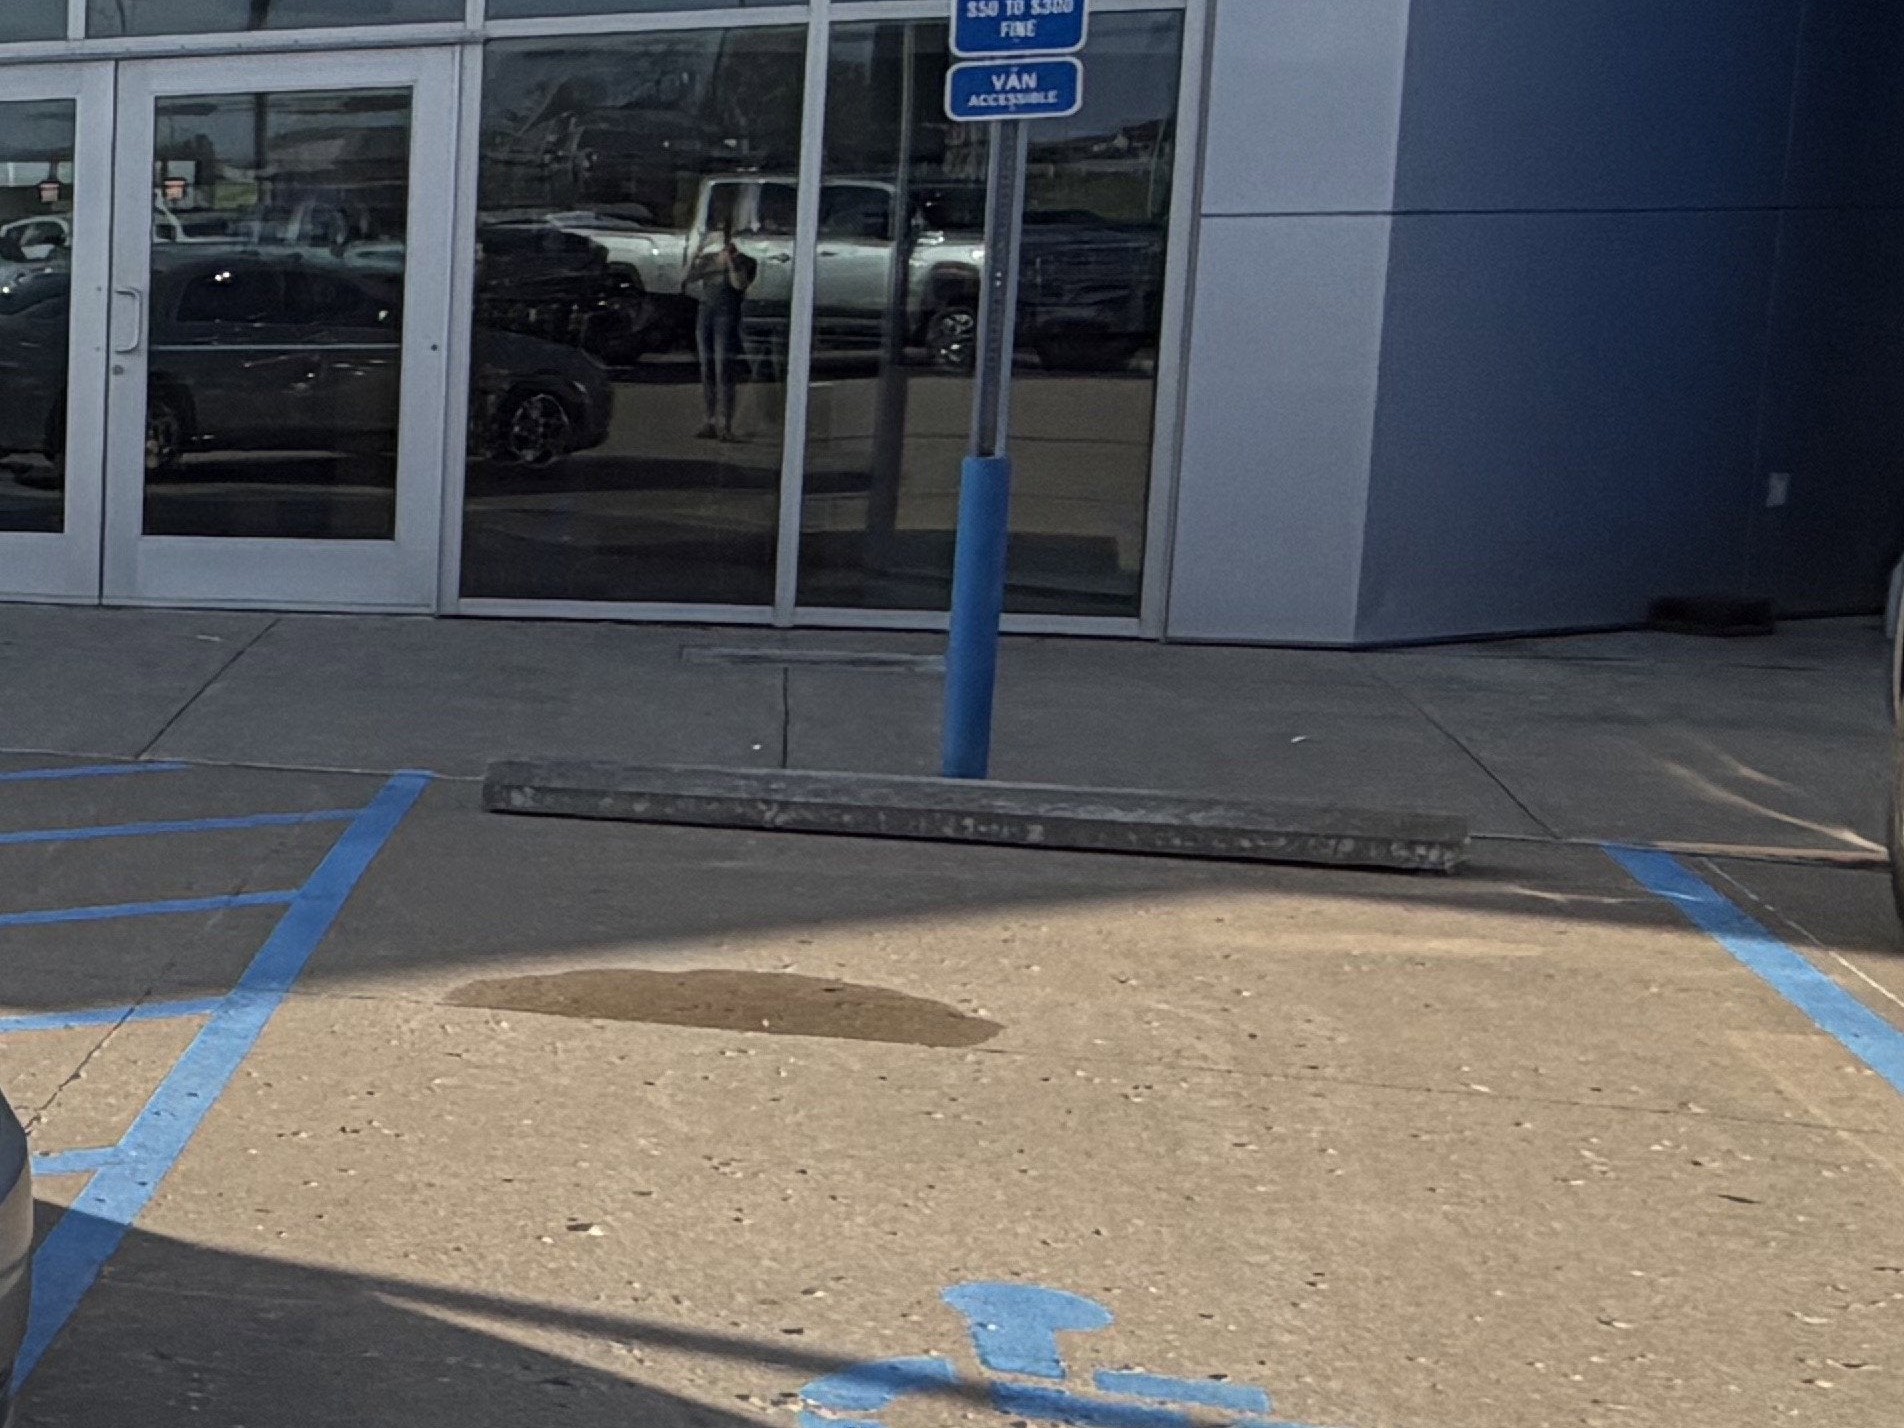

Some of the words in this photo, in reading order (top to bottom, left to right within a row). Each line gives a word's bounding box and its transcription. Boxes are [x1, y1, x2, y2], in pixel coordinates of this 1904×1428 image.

[1000, 19, 1036, 38] FINE
[992, 72, 1038, 90] VAN
[968, 90, 1058, 107] ACCESSIBLE
